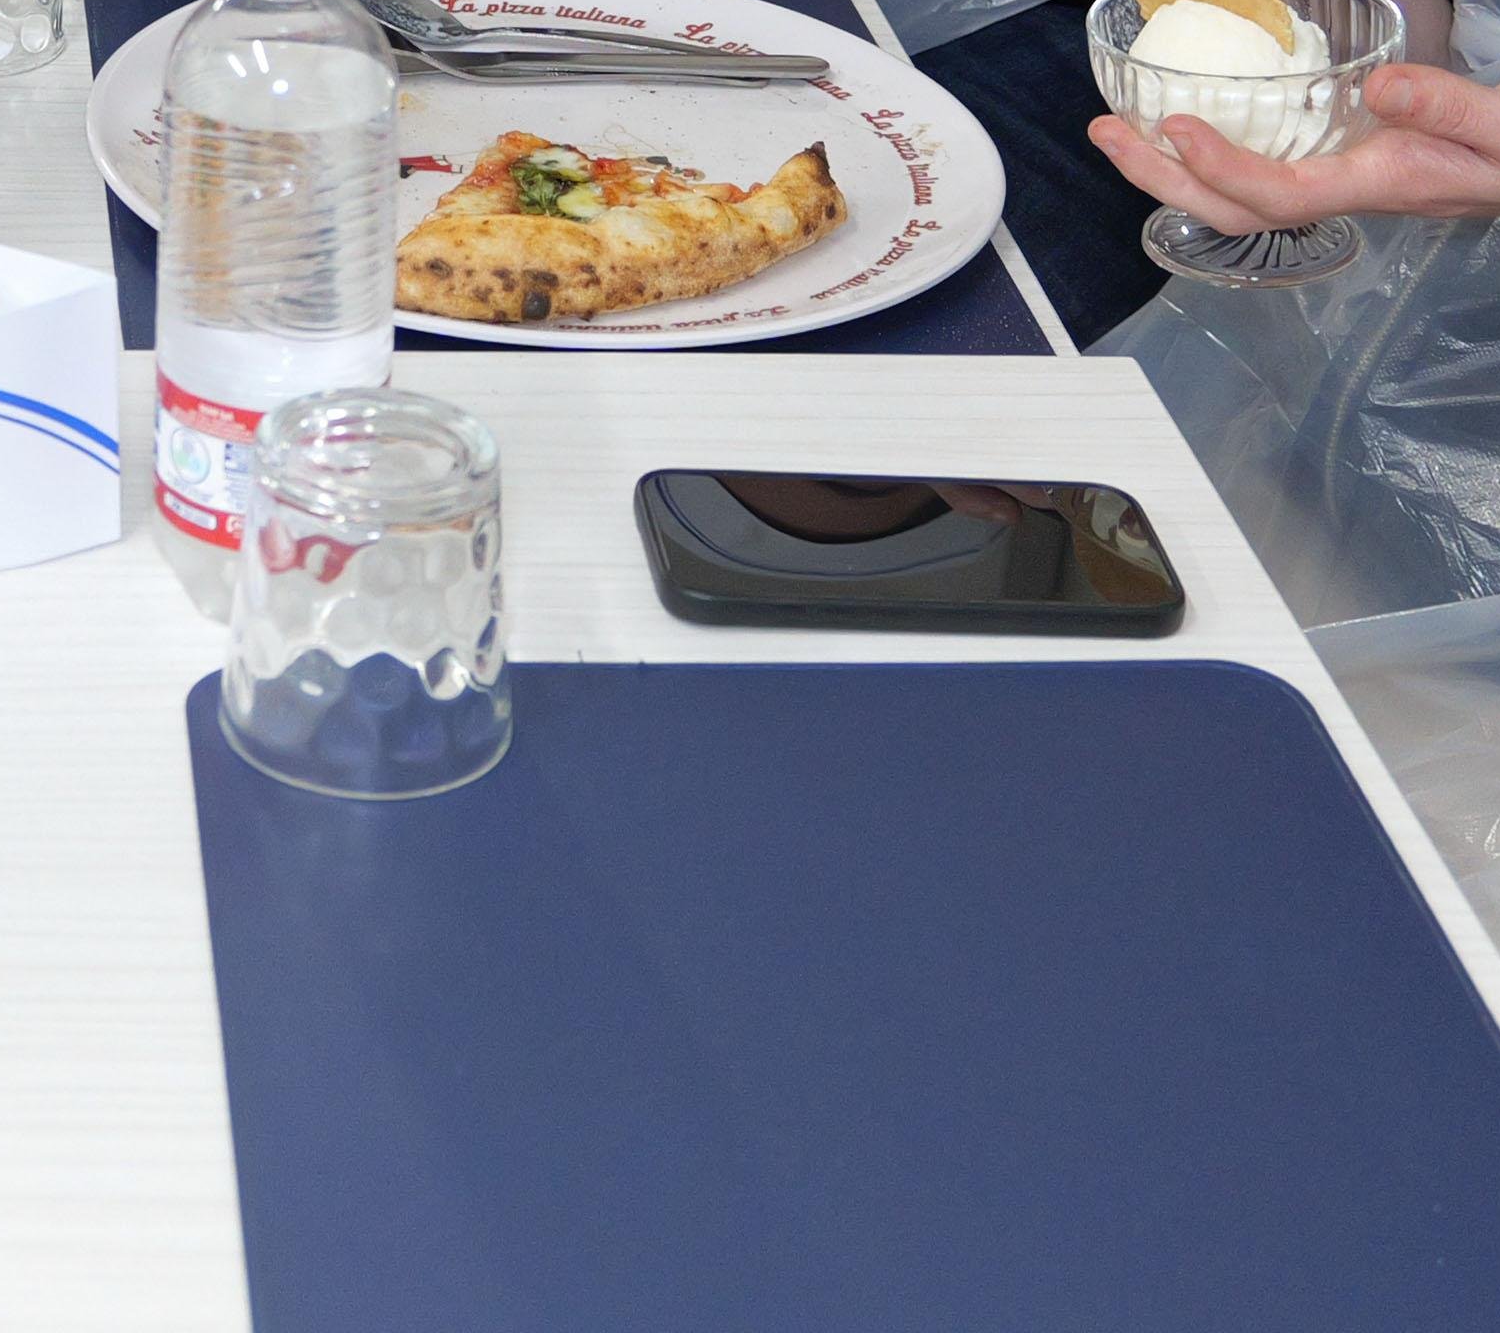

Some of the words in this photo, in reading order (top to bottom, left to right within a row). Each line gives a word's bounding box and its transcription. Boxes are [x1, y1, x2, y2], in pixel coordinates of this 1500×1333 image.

[478, 0, 546, 17] pizza
[554, 4, 648, 30] italiana
[673, 22, 716, 44] La
[861, 108, 904, 131] La
[873, 130, 920, 162] pizza
